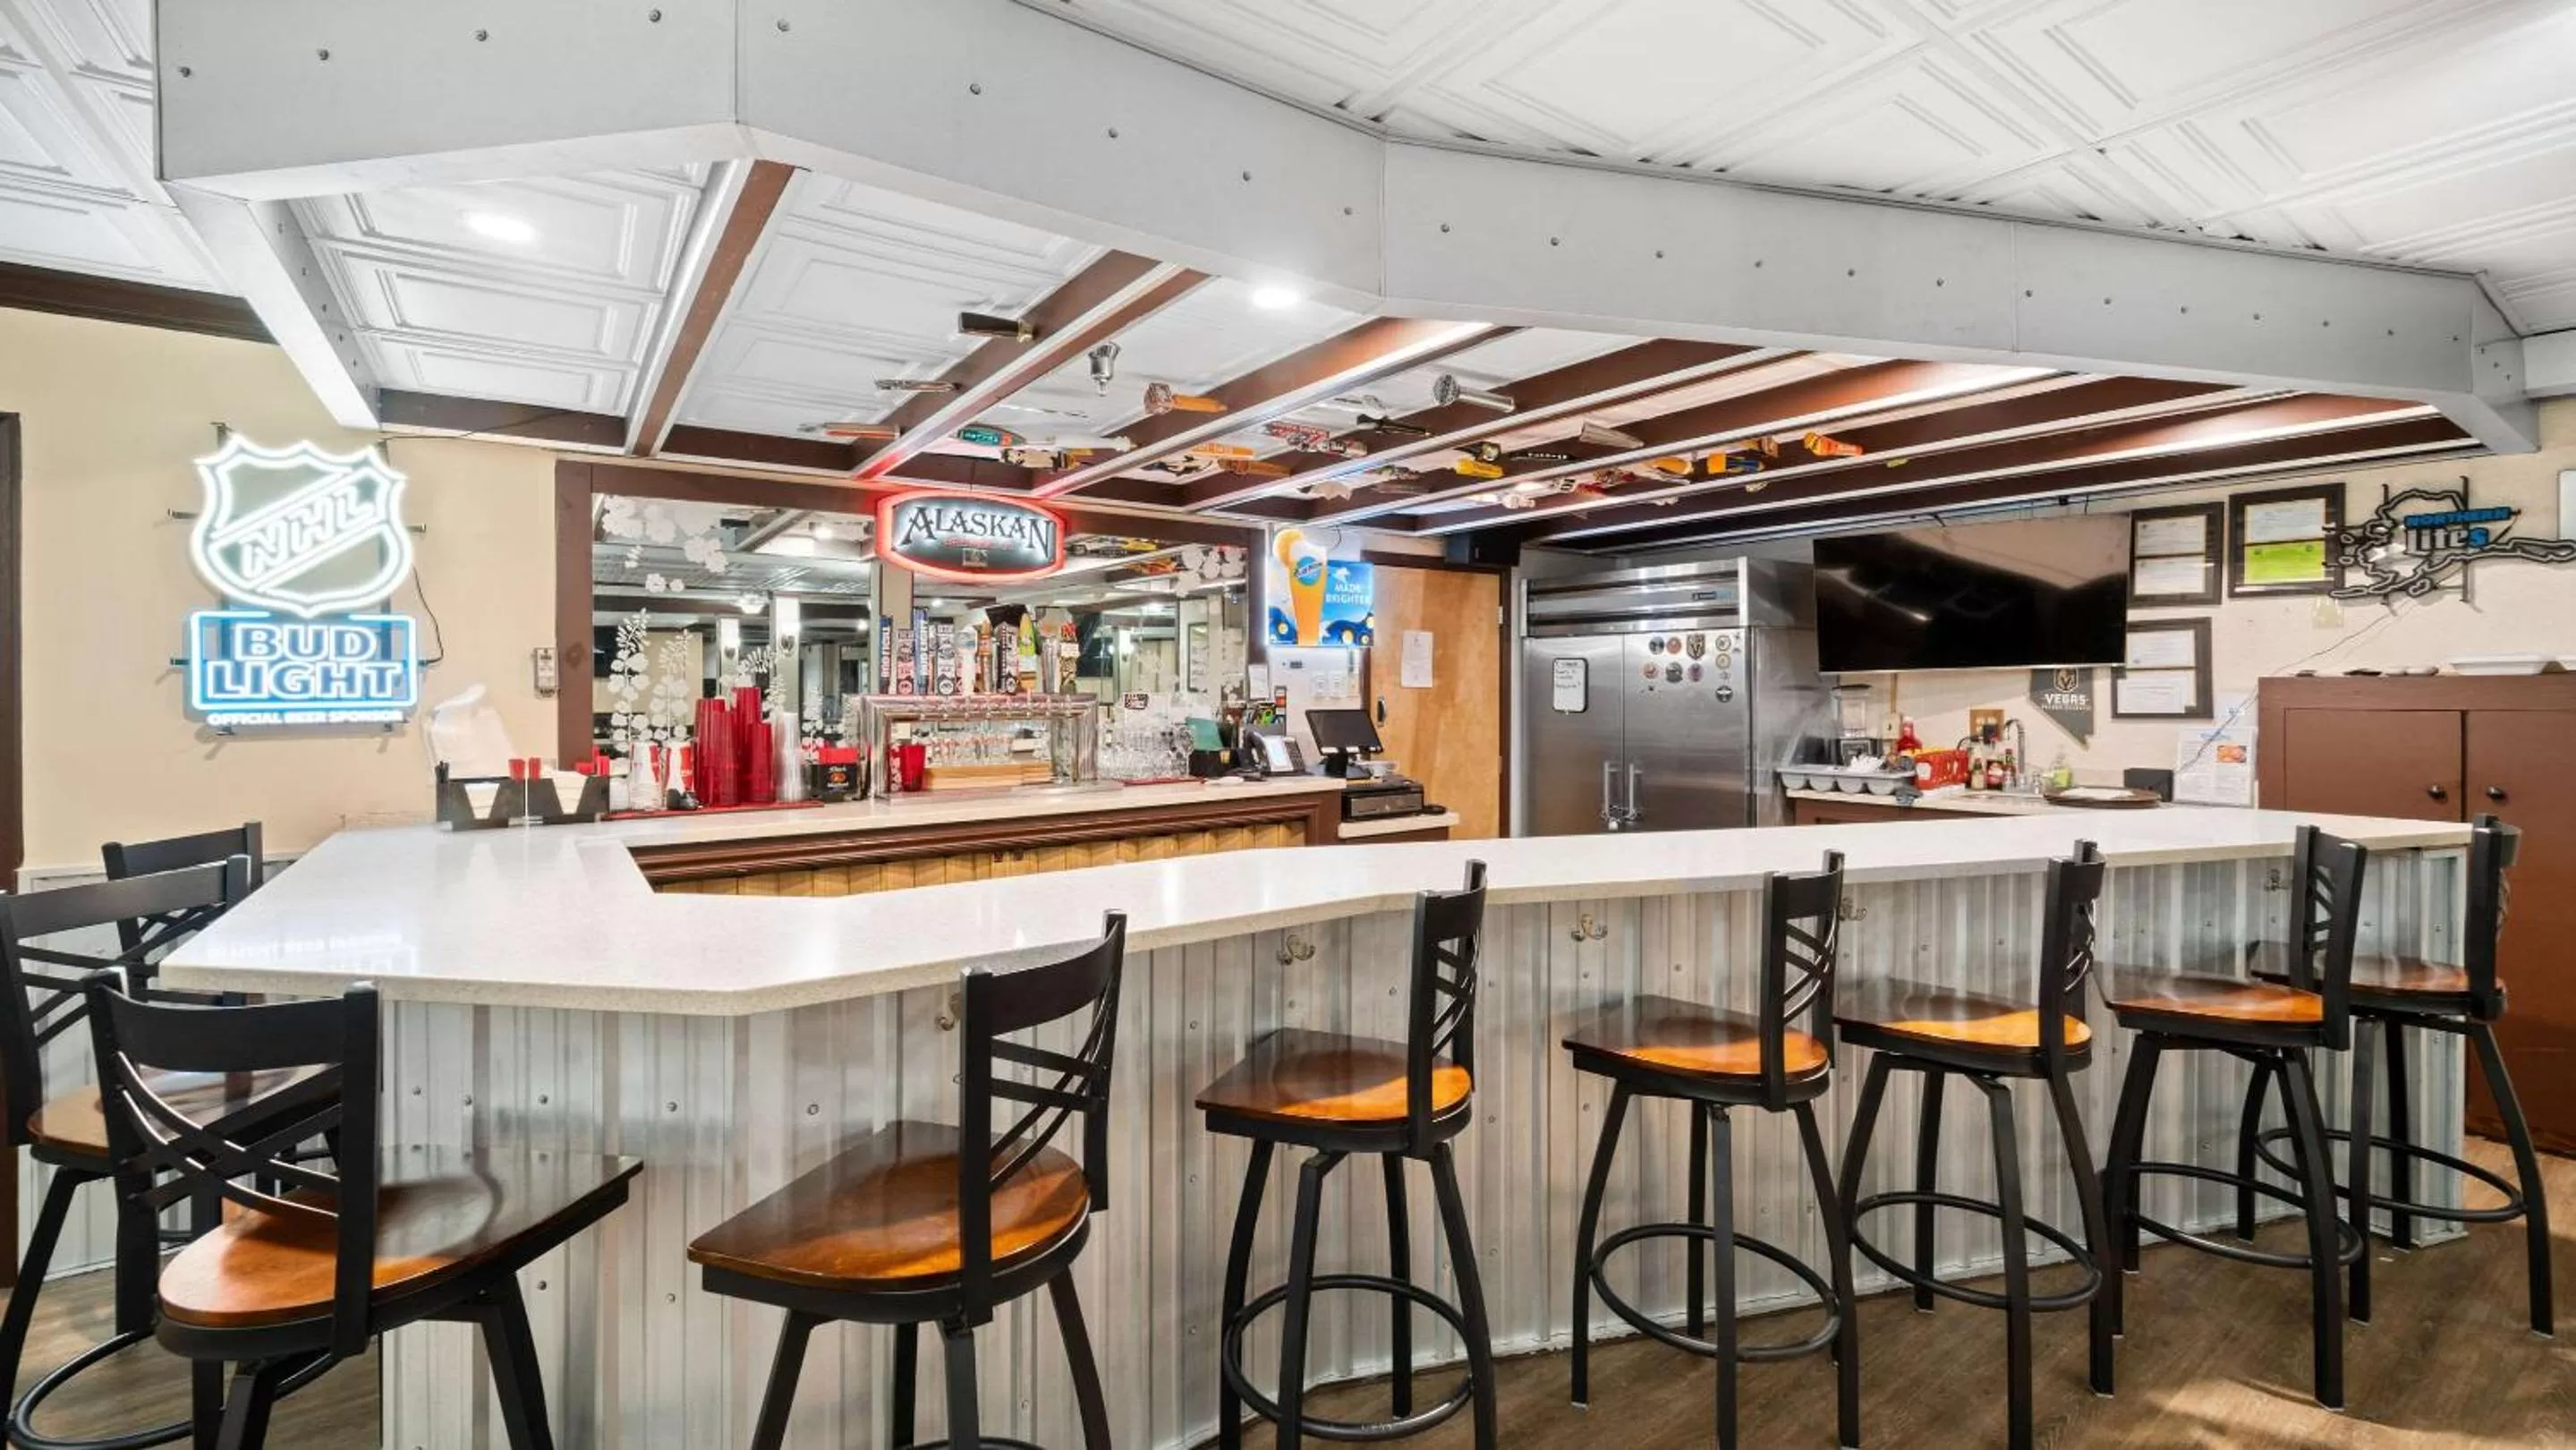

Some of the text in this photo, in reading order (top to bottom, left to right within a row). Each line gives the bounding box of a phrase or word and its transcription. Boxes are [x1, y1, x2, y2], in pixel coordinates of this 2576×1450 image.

[238, 483, 374, 580] NHL
[901, 506, 1054, 559] ALASKAN
[2406, 508, 2510, 528] NORTHERN
[233, 622, 378, 661] BUD
[206, 660, 403, 700] LIGHT
[2045, 693, 2087, 705] VEGAS
[206, 712, 283, 726] OFFICIAL
